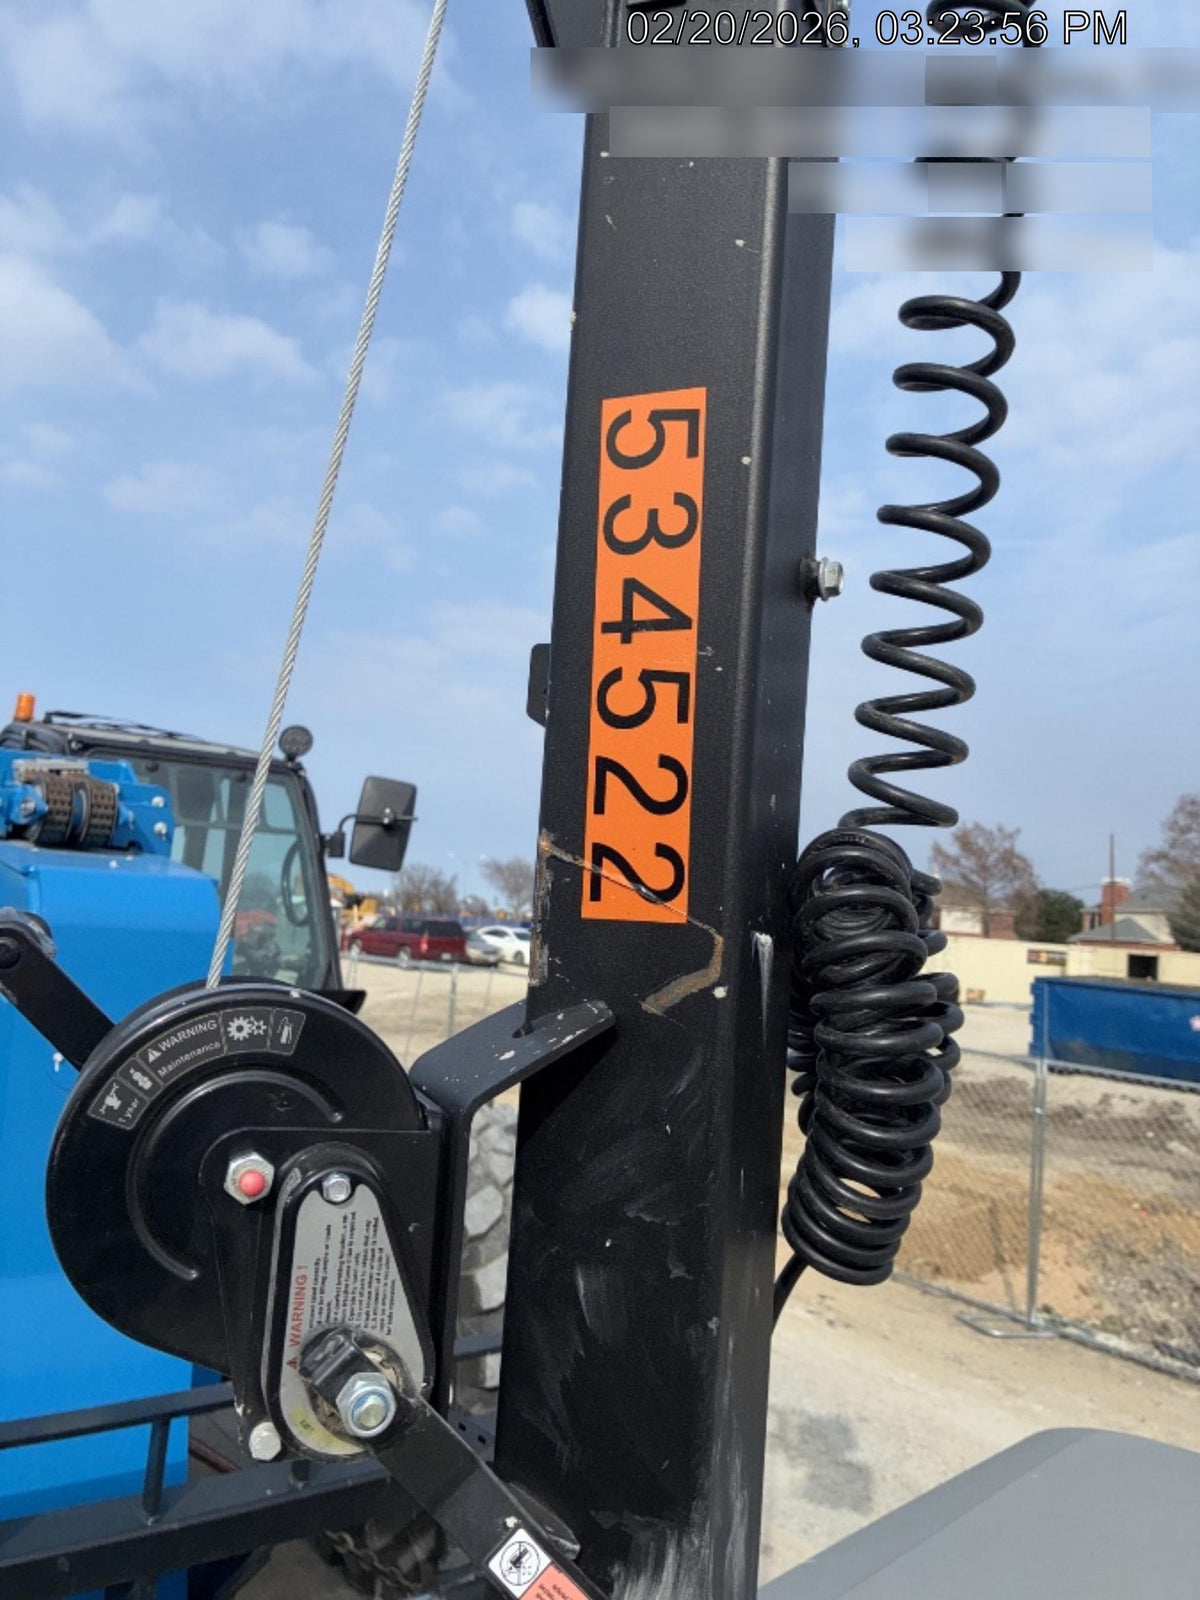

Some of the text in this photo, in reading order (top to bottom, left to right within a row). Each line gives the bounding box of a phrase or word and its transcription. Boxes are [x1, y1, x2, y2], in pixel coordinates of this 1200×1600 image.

[590, 408, 700, 903] 534522
[157, 1041, 221, 1078] Maintenance
[158, 1020, 218, 1051] WARNING
[288, 1274, 307, 1348] WARNING
